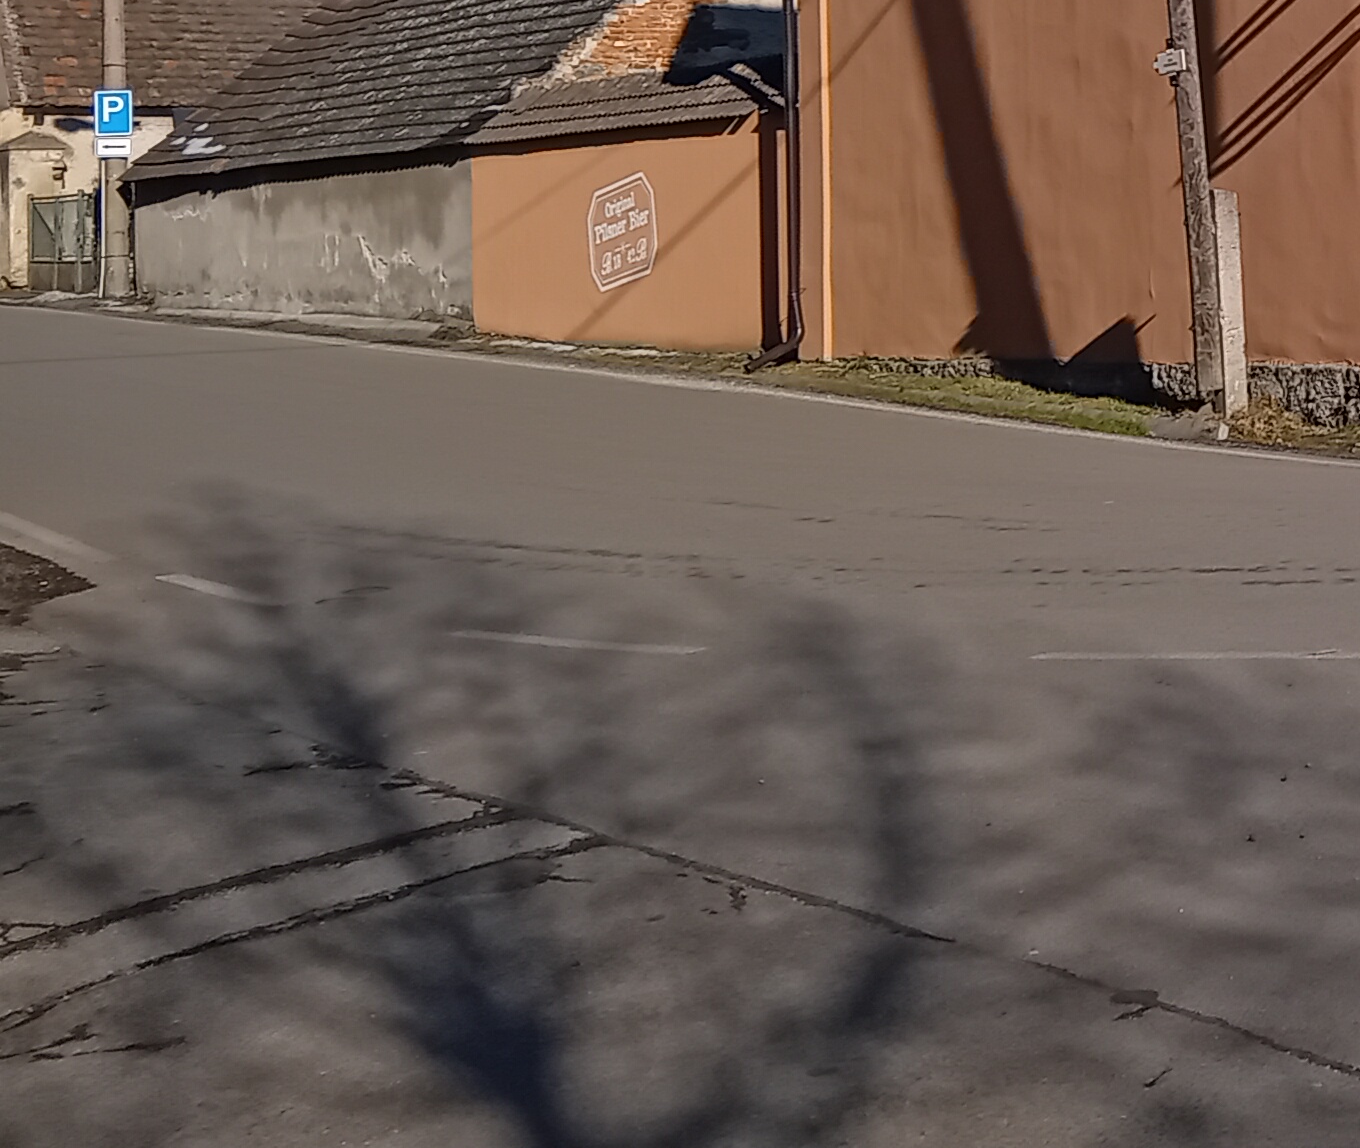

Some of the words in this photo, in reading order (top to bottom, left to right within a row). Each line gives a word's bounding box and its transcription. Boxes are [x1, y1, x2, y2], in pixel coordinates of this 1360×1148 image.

[102, 96, 124, 123] P
[605, 191, 635, 218] Original
[594, 219, 627, 245] Pilsner
[628, 208, 650, 231] Bier
